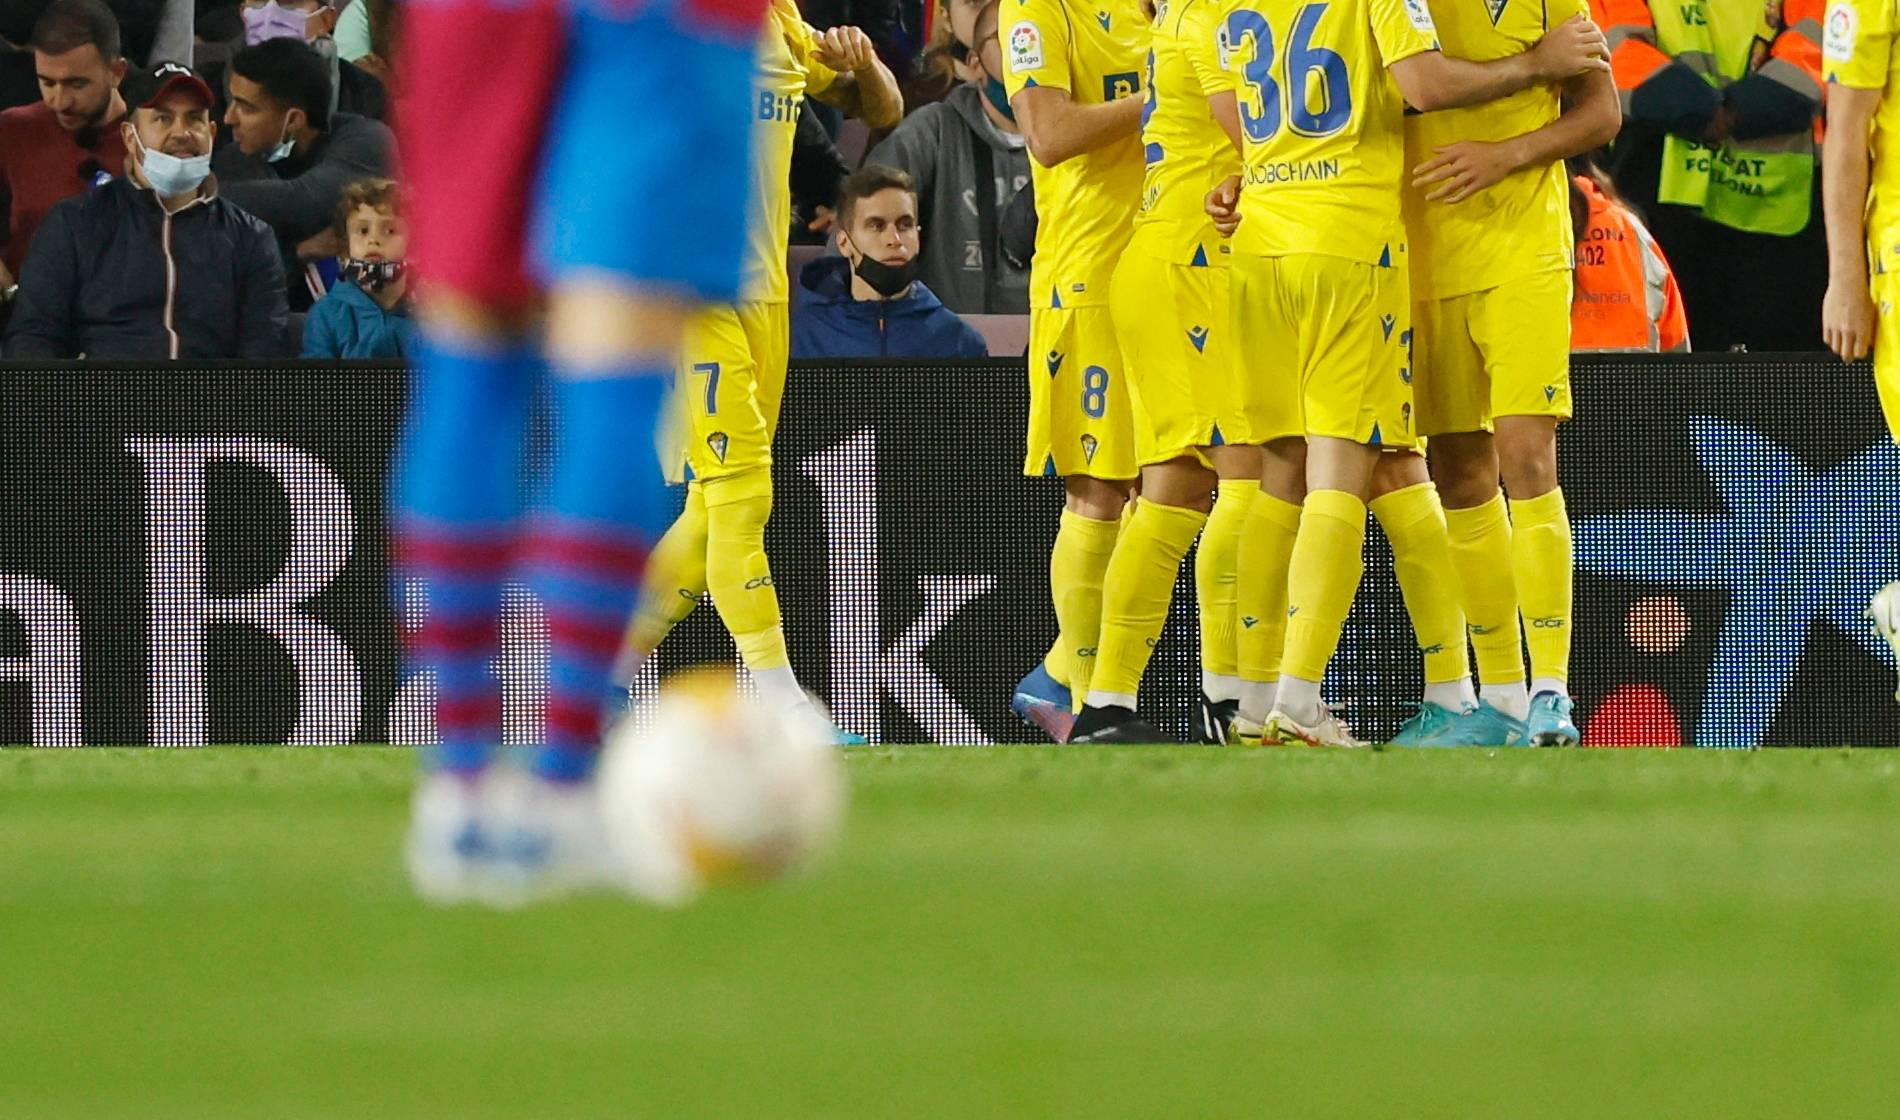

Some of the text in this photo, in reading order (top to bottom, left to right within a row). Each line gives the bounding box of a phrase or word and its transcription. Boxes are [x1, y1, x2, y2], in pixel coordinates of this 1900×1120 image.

[1226, 1, 1353, 144] 36
[692, 361, 720, 417] 7
[1082, 364, 1109, 419] 8
